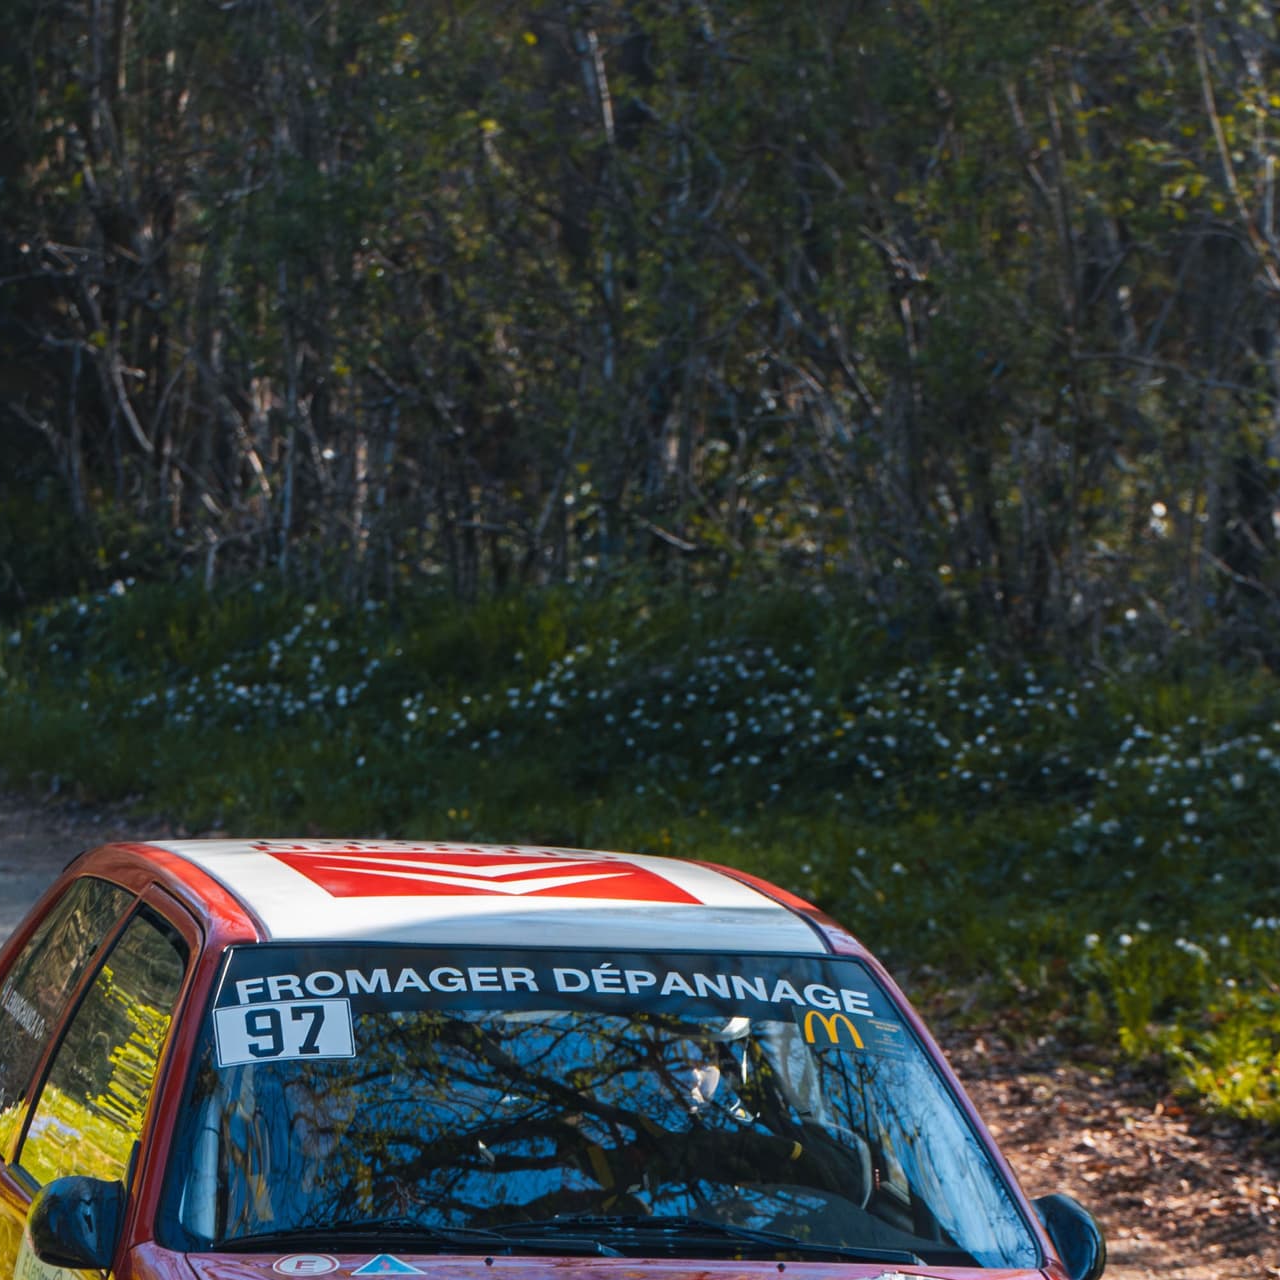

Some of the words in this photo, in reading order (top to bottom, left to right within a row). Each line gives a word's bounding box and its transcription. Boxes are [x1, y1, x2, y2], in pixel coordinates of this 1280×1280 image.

[235, 966, 540, 1004] FROMAGER
[553, 963, 874, 1016] DÉPANNAGE
[246, 1004, 326, 1058] 97
